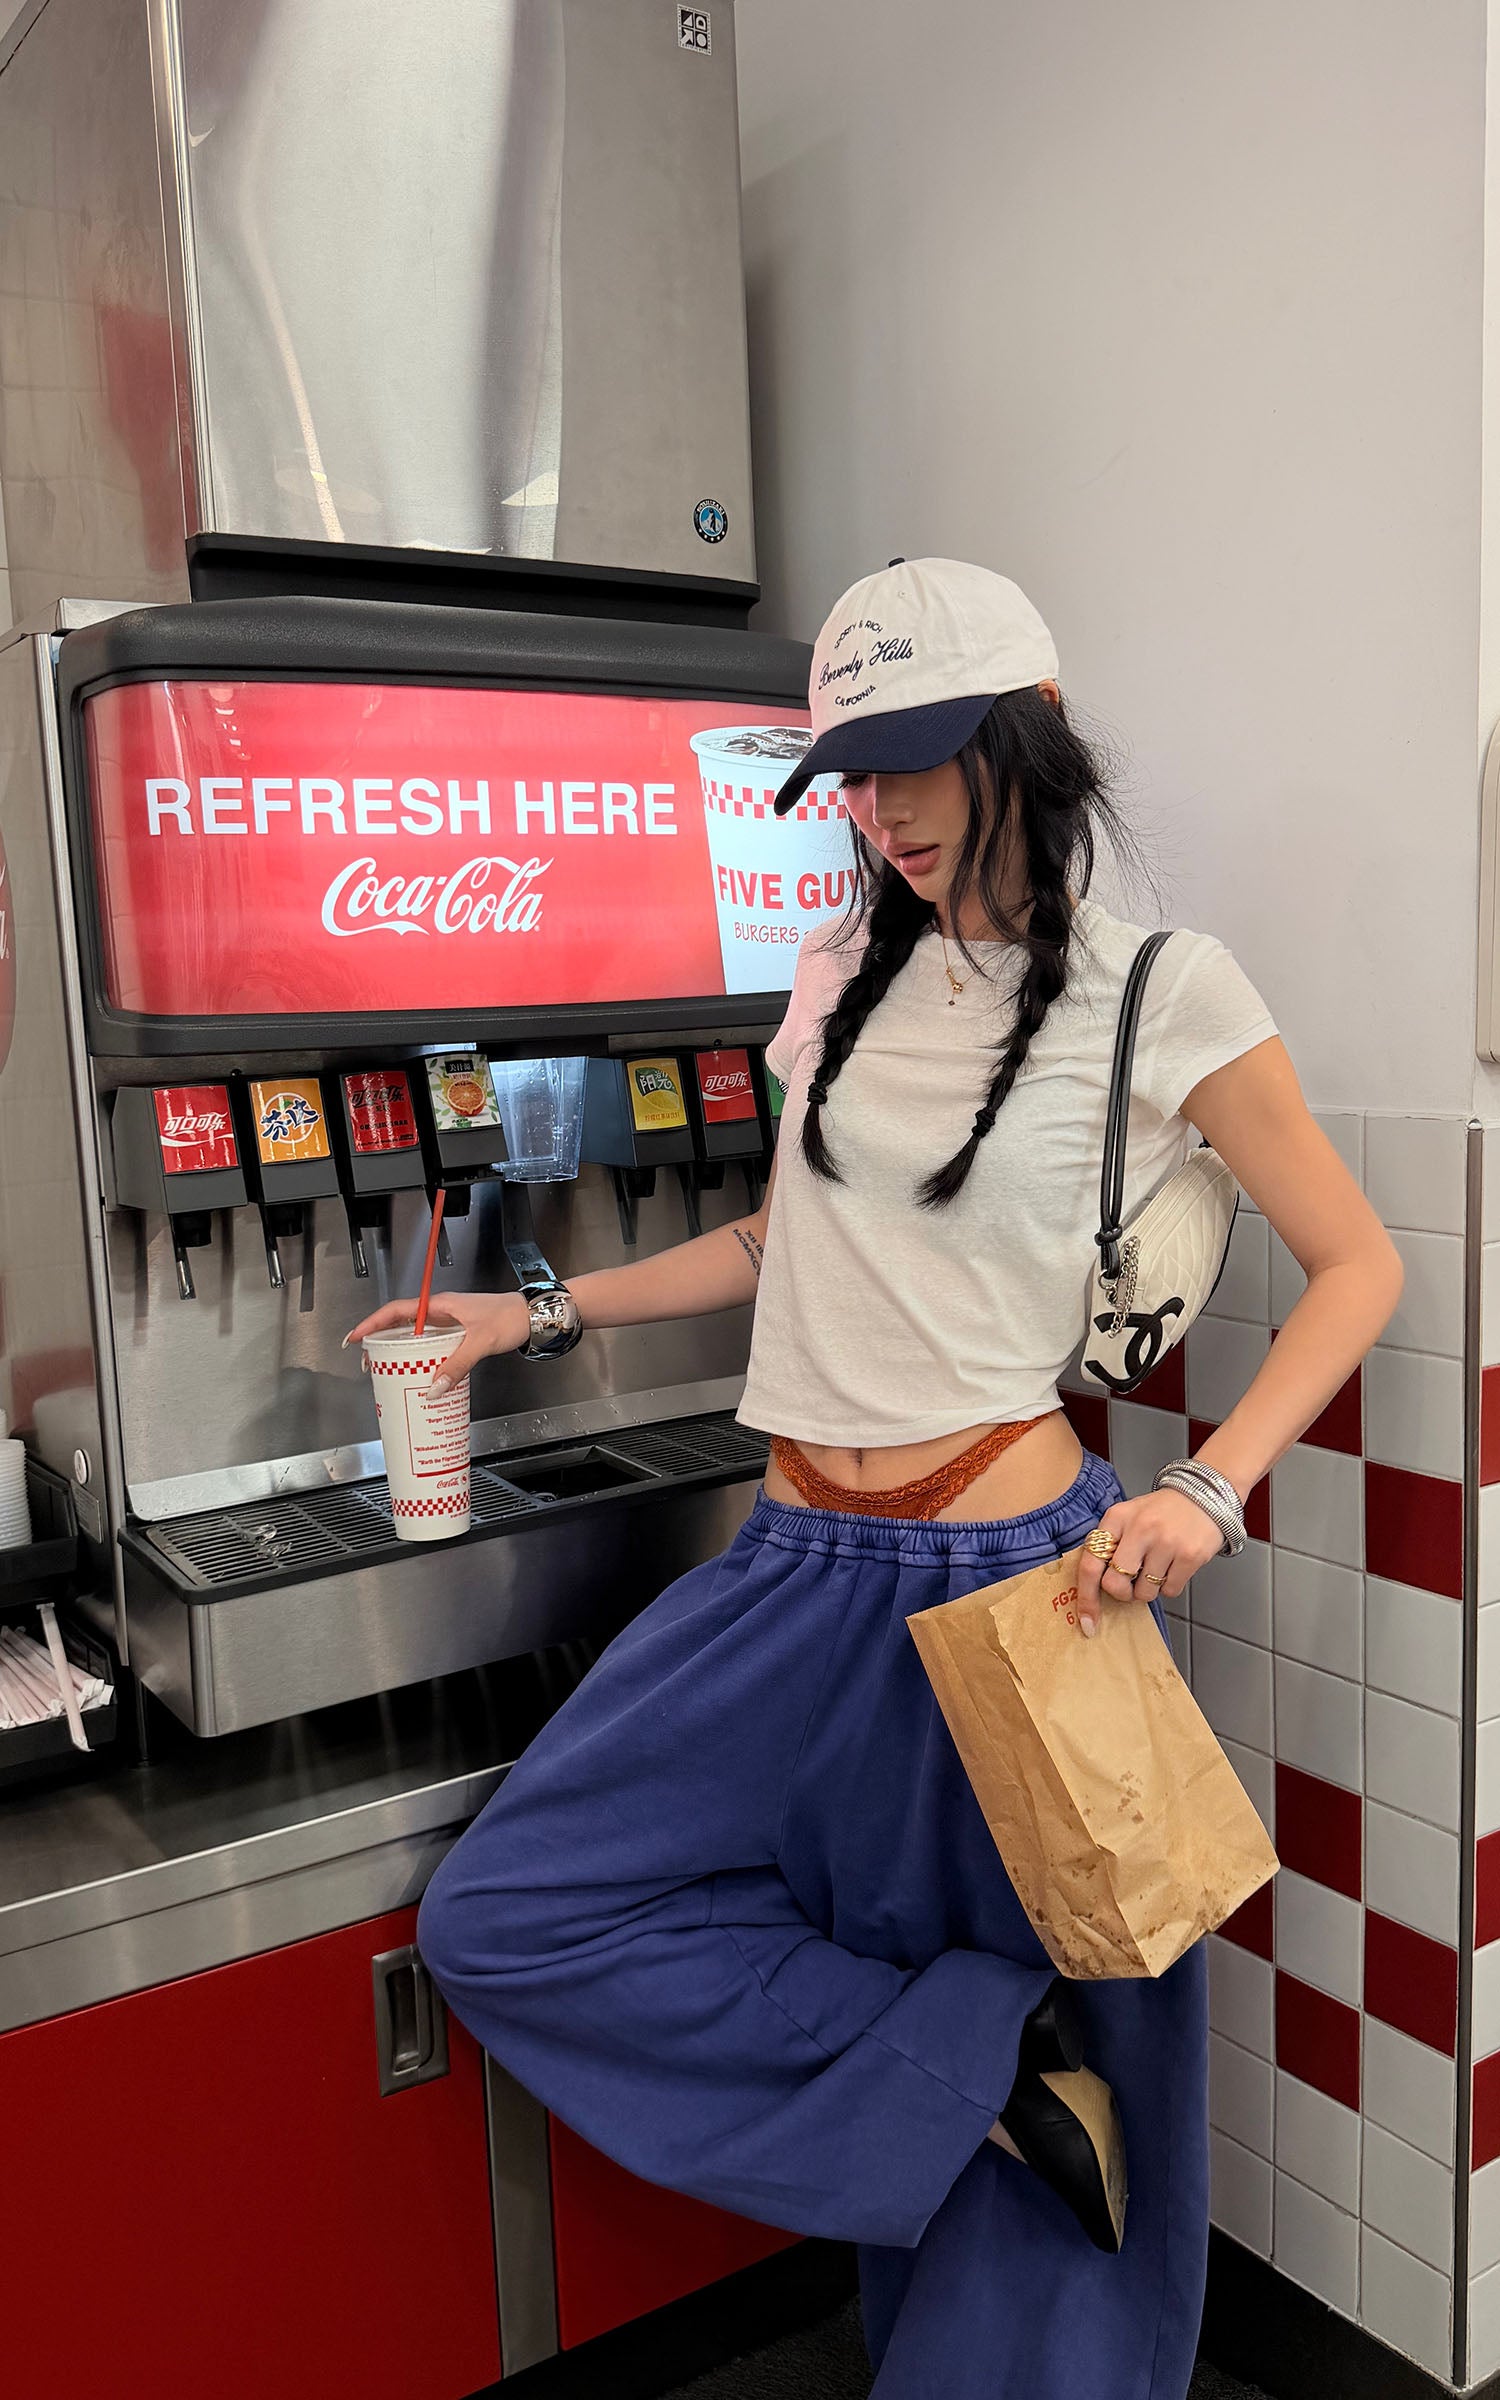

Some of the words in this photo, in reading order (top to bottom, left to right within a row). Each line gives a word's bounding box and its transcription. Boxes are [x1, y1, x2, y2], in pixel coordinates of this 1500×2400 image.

[865, 619, 883, 634] RICH
[818, 650, 864, 691] Beverly
[869, 638, 914, 666] Hills
[145, 777, 492, 836] REFRESH
[514, 781, 678, 835] HERE
[322, 856, 554, 937] Coca-Cola
[717, 864, 784, 910] FIVE
[796, 868, 860, 911] GUY
[734, 921, 799, 944] BURGERS
[704, 1070, 750, 1092] 可口可乐
[163, 1111, 229, 1137] 可口可乐
[261, 1099, 322, 1143] 芬达
[1066, 1611, 1075, 1625] 6
